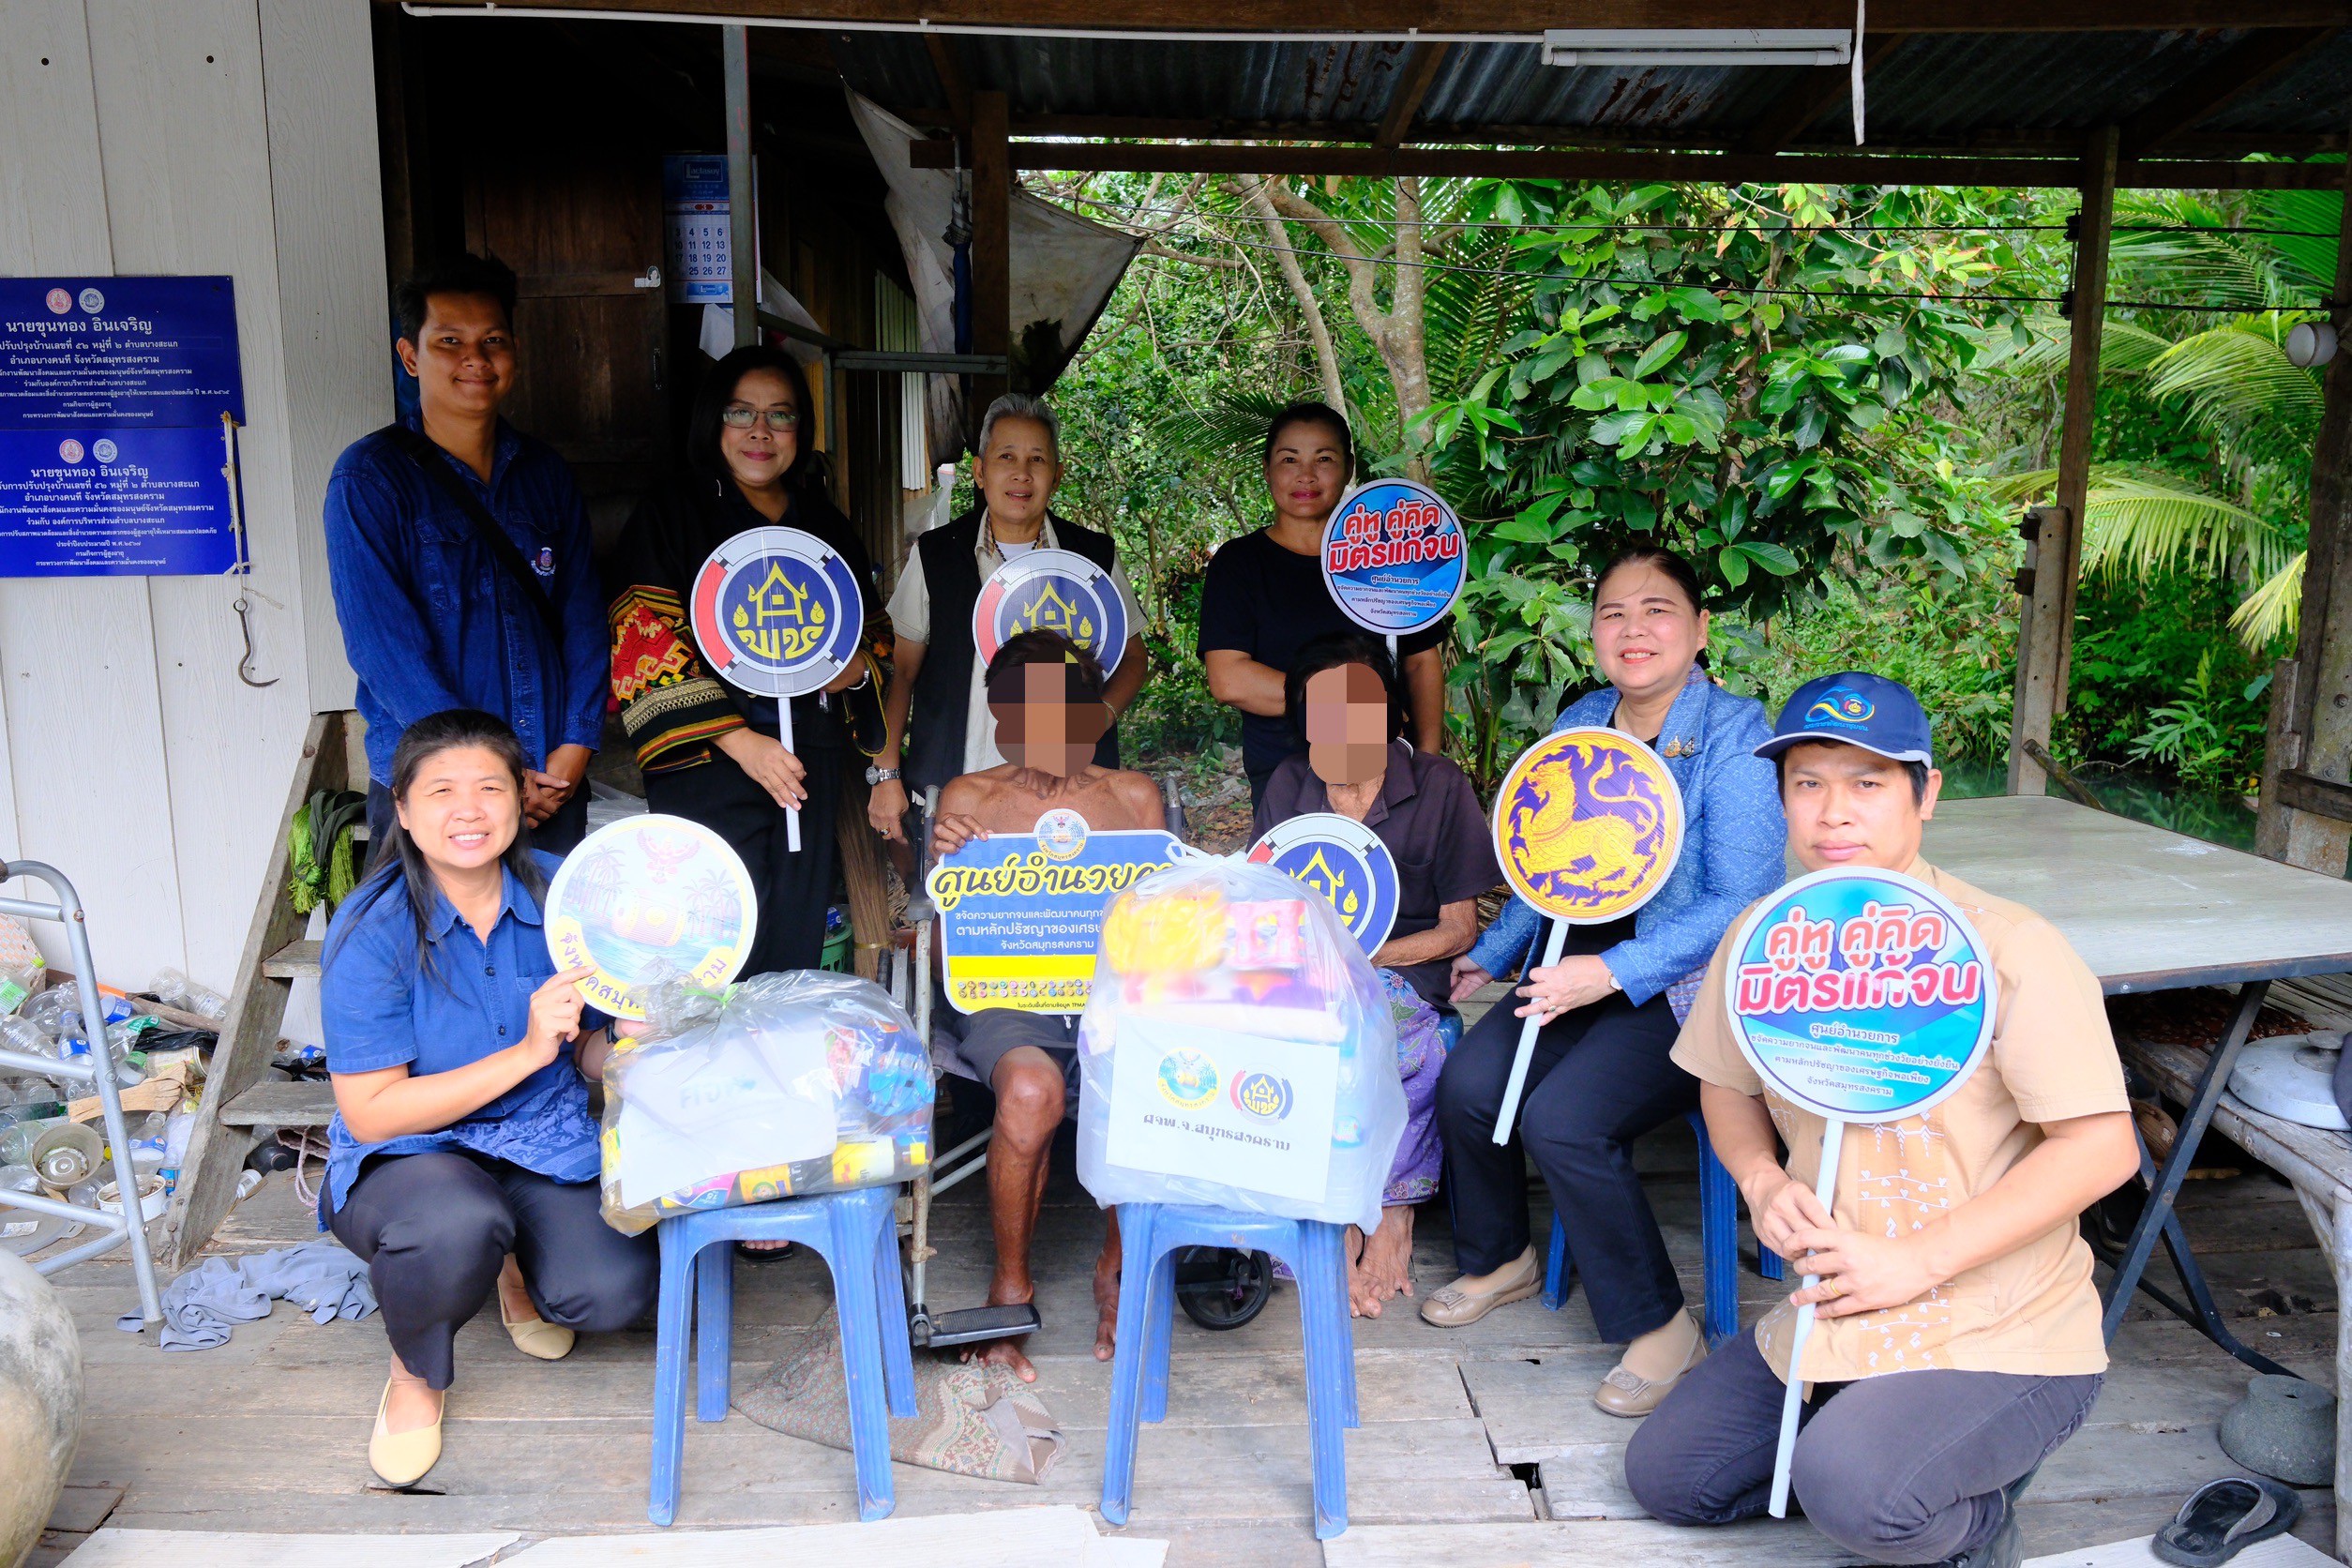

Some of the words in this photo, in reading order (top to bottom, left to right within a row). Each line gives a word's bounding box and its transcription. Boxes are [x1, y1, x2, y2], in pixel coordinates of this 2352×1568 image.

[675, 228, 681, 236] 3
[688, 228, 695, 236] 4
[703, 228, 709, 236] 5
[716, 228, 723, 236] 6
[674, 240, 683, 249] 10
[688, 240, 697, 249] 11
[701, 240, 711, 249] 12
[716, 240, 725, 249] 13
[675, 253, 683, 263] 17
[688, 253, 698, 263] 18
[702, 253, 712, 263] 19
[716, 253, 726, 263] 20
[688, 266, 699, 276] 25
[702, 266, 713, 276] 26
[716, 266, 727, 276] 27
[6, 321, 86, 338] นายขุนทอง
[91, 317, 153, 335] อินเจริญ
[92, 337, 113, 353] หมู่ที่
[125, 339, 178, 349] ตำบลบางสะแก
[74, 354, 160, 367] จังหวัดสมุทรสงคราม
[31, 467, 96, 481] นายขุนทอง
[99, 464, 149, 478] อินเจริญ
[110, 477, 128, 491] หมู่ที่
[141, 479, 200, 489] ตำบลบางสะแก
[84, 491, 165, 503] จังหวัดสมุทรสงคราม
[26, 517, 50, 525] ร่วมกับ
[53, 517, 165, 525] องค์การบริหารส่วนตำบลบางสะแก
[1344, 505, 1380, 543] คู่หู
[1386, 500, 1440, 539] คู่คิด
[1329, 529, 1458, 571] มิตรแก้จน
[1370, 574, 1420, 584] ศูนย์อำนวยการ
[1769, 910, 1829, 972] คู่หู
[1843, 904, 1942, 967] คู่คิด
[1001, 940, 1094, 952] จังหวัดสมุทรสงคราม
[1739, 954, 1978, 1011] มิตรแก้จน
[1810, 1021, 1899, 1045] ศูนย์อำนวยการ
[1806, 1077, 1893, 1096] จังหวัดสมุทรสงคราม
